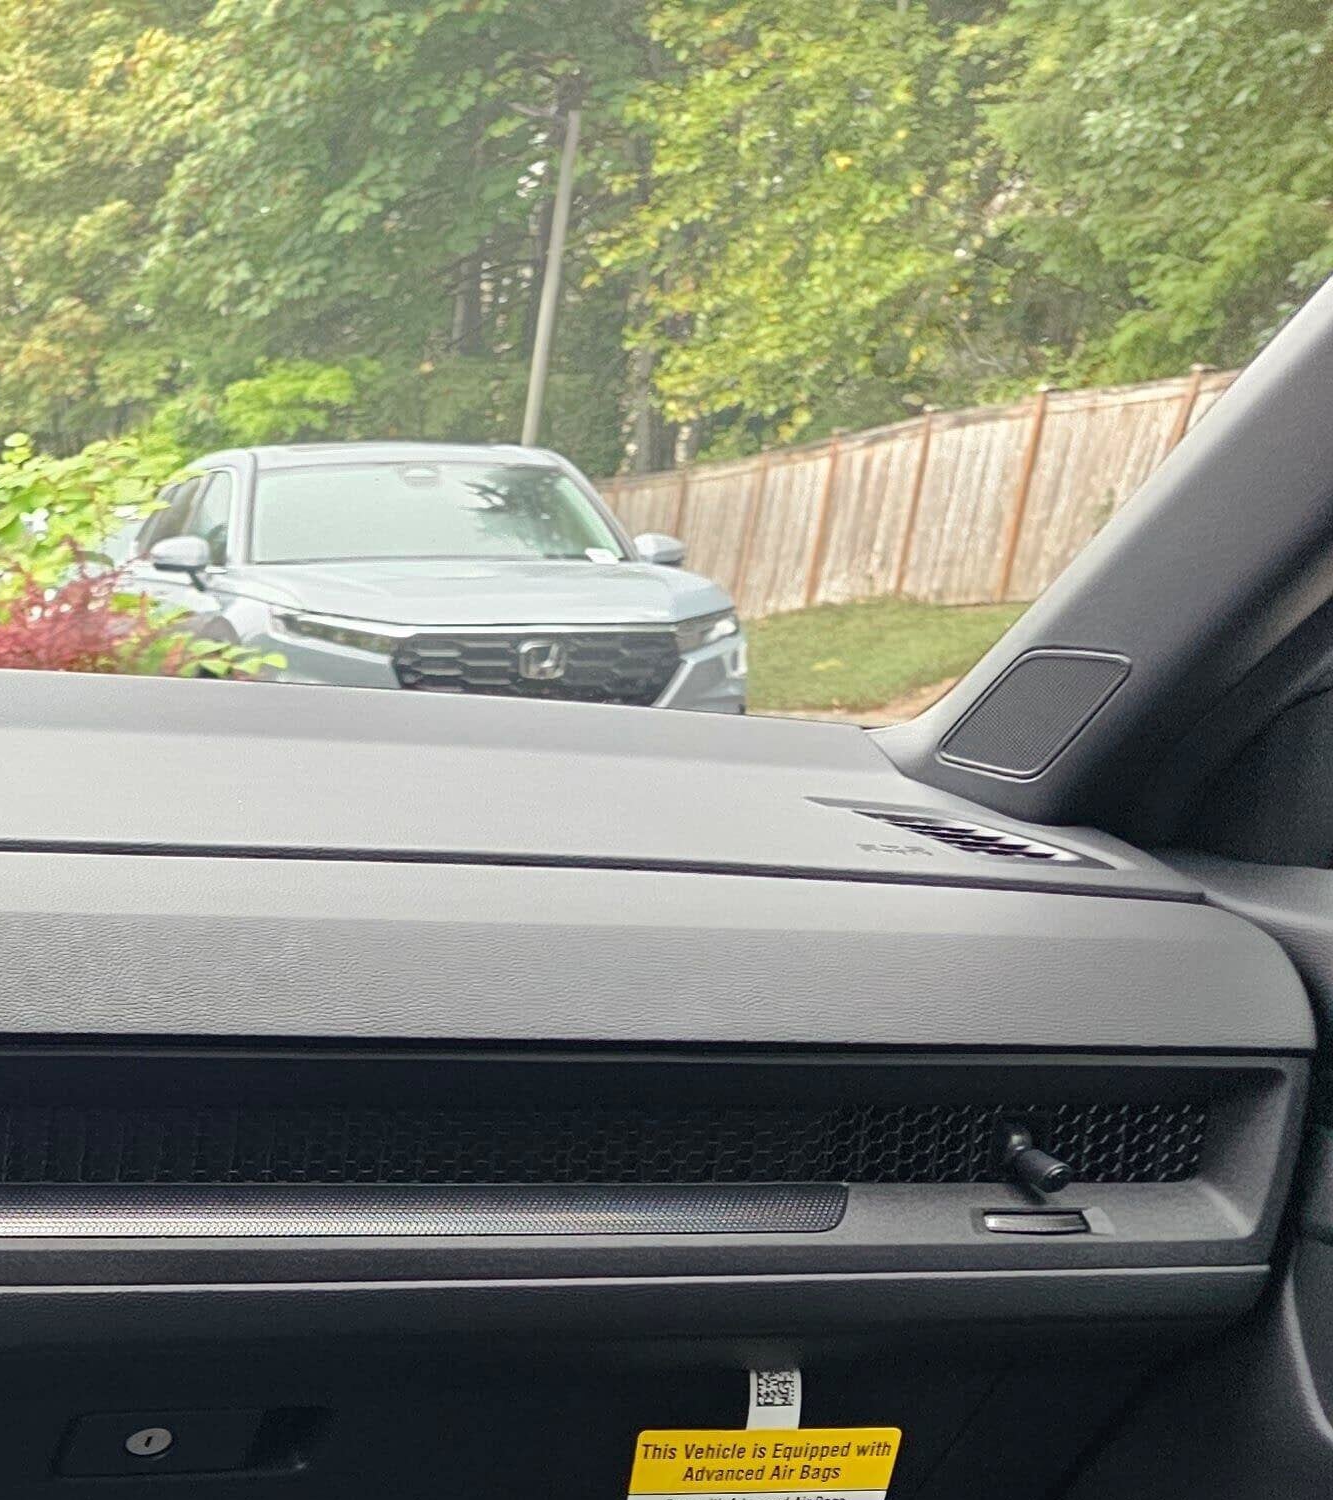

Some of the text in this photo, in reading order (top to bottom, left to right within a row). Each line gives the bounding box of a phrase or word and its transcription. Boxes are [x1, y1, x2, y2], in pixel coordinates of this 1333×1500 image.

[642, 1441, 892, 1461] This Vehicle is Equipped with
[682, 1465, 842, 1482] Advanced Air Bags
